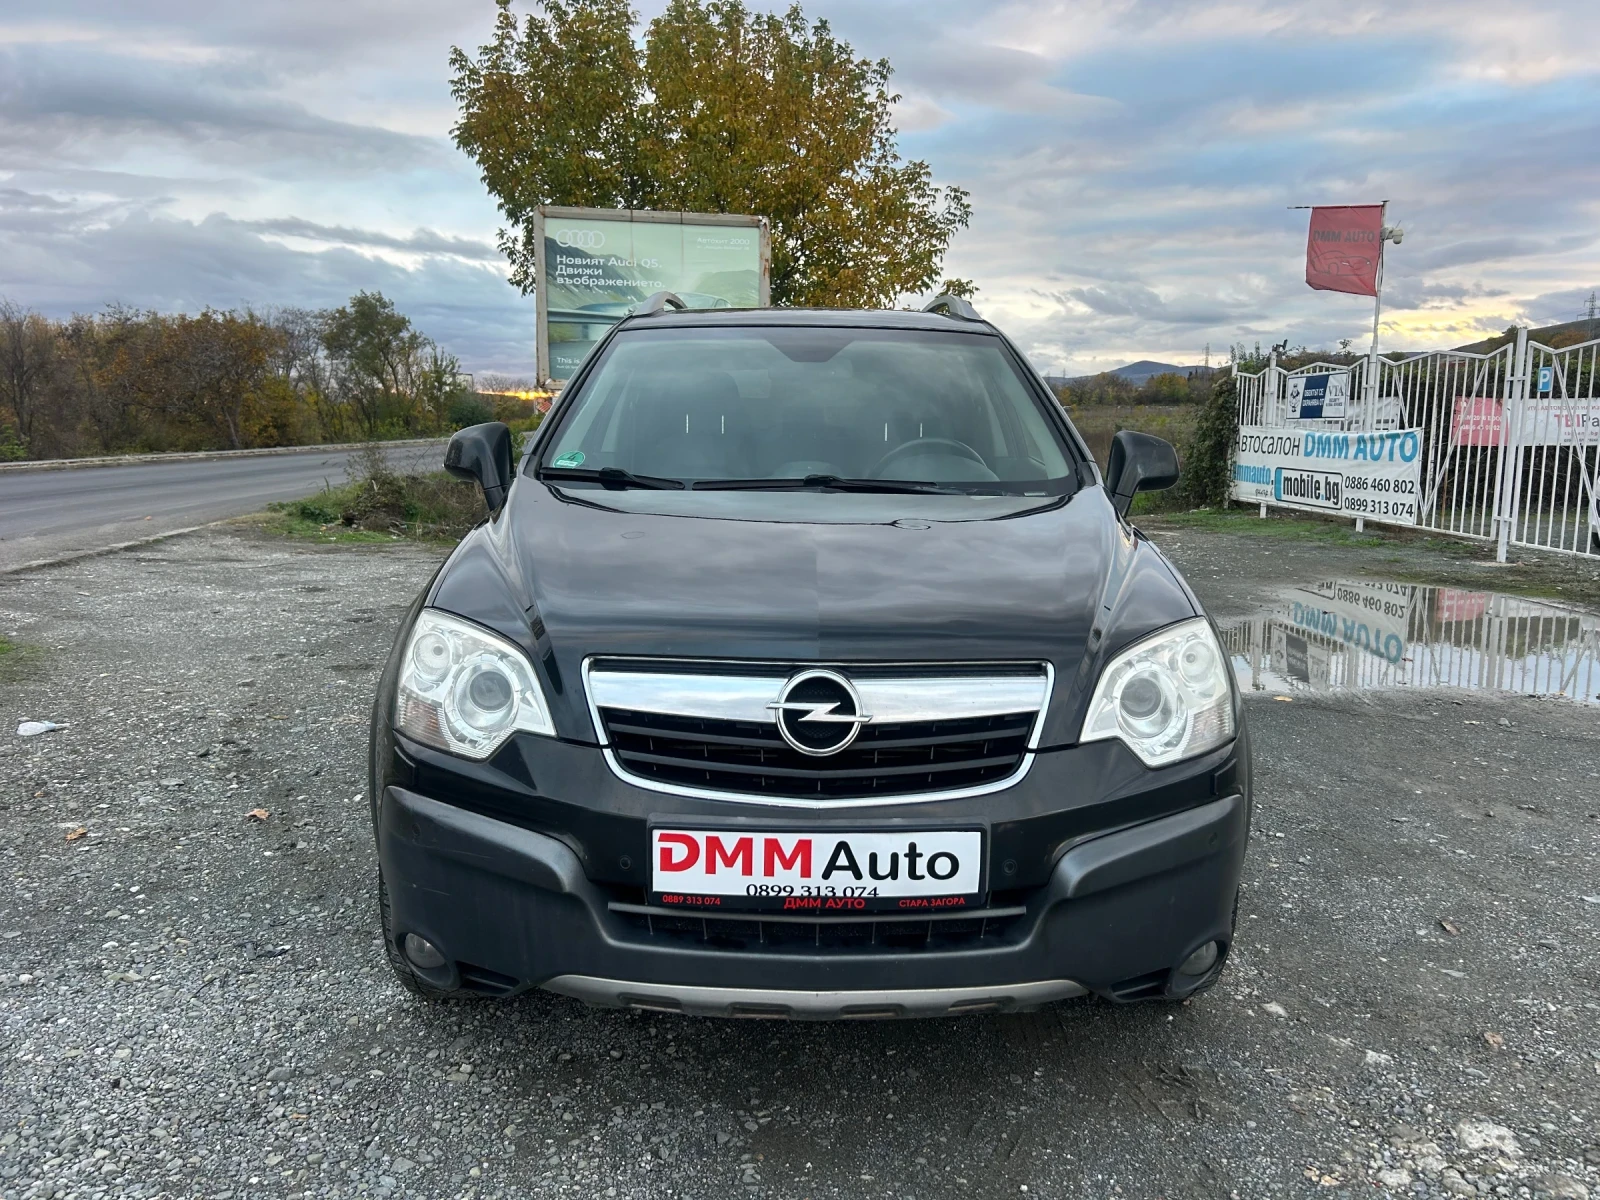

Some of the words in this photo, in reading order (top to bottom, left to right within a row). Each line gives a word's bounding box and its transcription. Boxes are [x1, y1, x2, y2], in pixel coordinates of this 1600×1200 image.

[1313, 230, 1341, 242] DMM
[1344, 230, 1375, 242] AUTO
[556, 255, 604, 265] Новият
[608, 257, 636, 267] Audi
[641, 259, 662, 268] Q5.
[556, 265, 602, 275] Движи
[557, 276, 665, 288] въображението.
[1539, 370, 1549, 389] P
[1329, 385, 1344, 396] VTA
[1304, 432, 1349, 460] DMM
[1354, 432, 1418, 462] AUTO
[1283, 473, 1340, 505] mobile.bg
[1345, 476, 1368, 490] 0886
[1370, 478, 1390, 492] 460
[1393, 480, 1414, 494] 802
[1345, 497, 1367, 511] 0899
[1370, 500, 1389, 514] 313
[1392, 502, 1413, 517] 074
[658, 833, 812, 878] DMM
[821, 840, 960, 881] Auto
[746, 884, 795, 896] 0899
[801, 886, 837, 897] 313
[842, 886, 879, 897] 074
[686, 896, 702, 905] 313
[784, 897, 821, 909] ДММ
[825, 898, 865, 909] АУТО
[930, 897, 965, 906] ЗАГОРА
